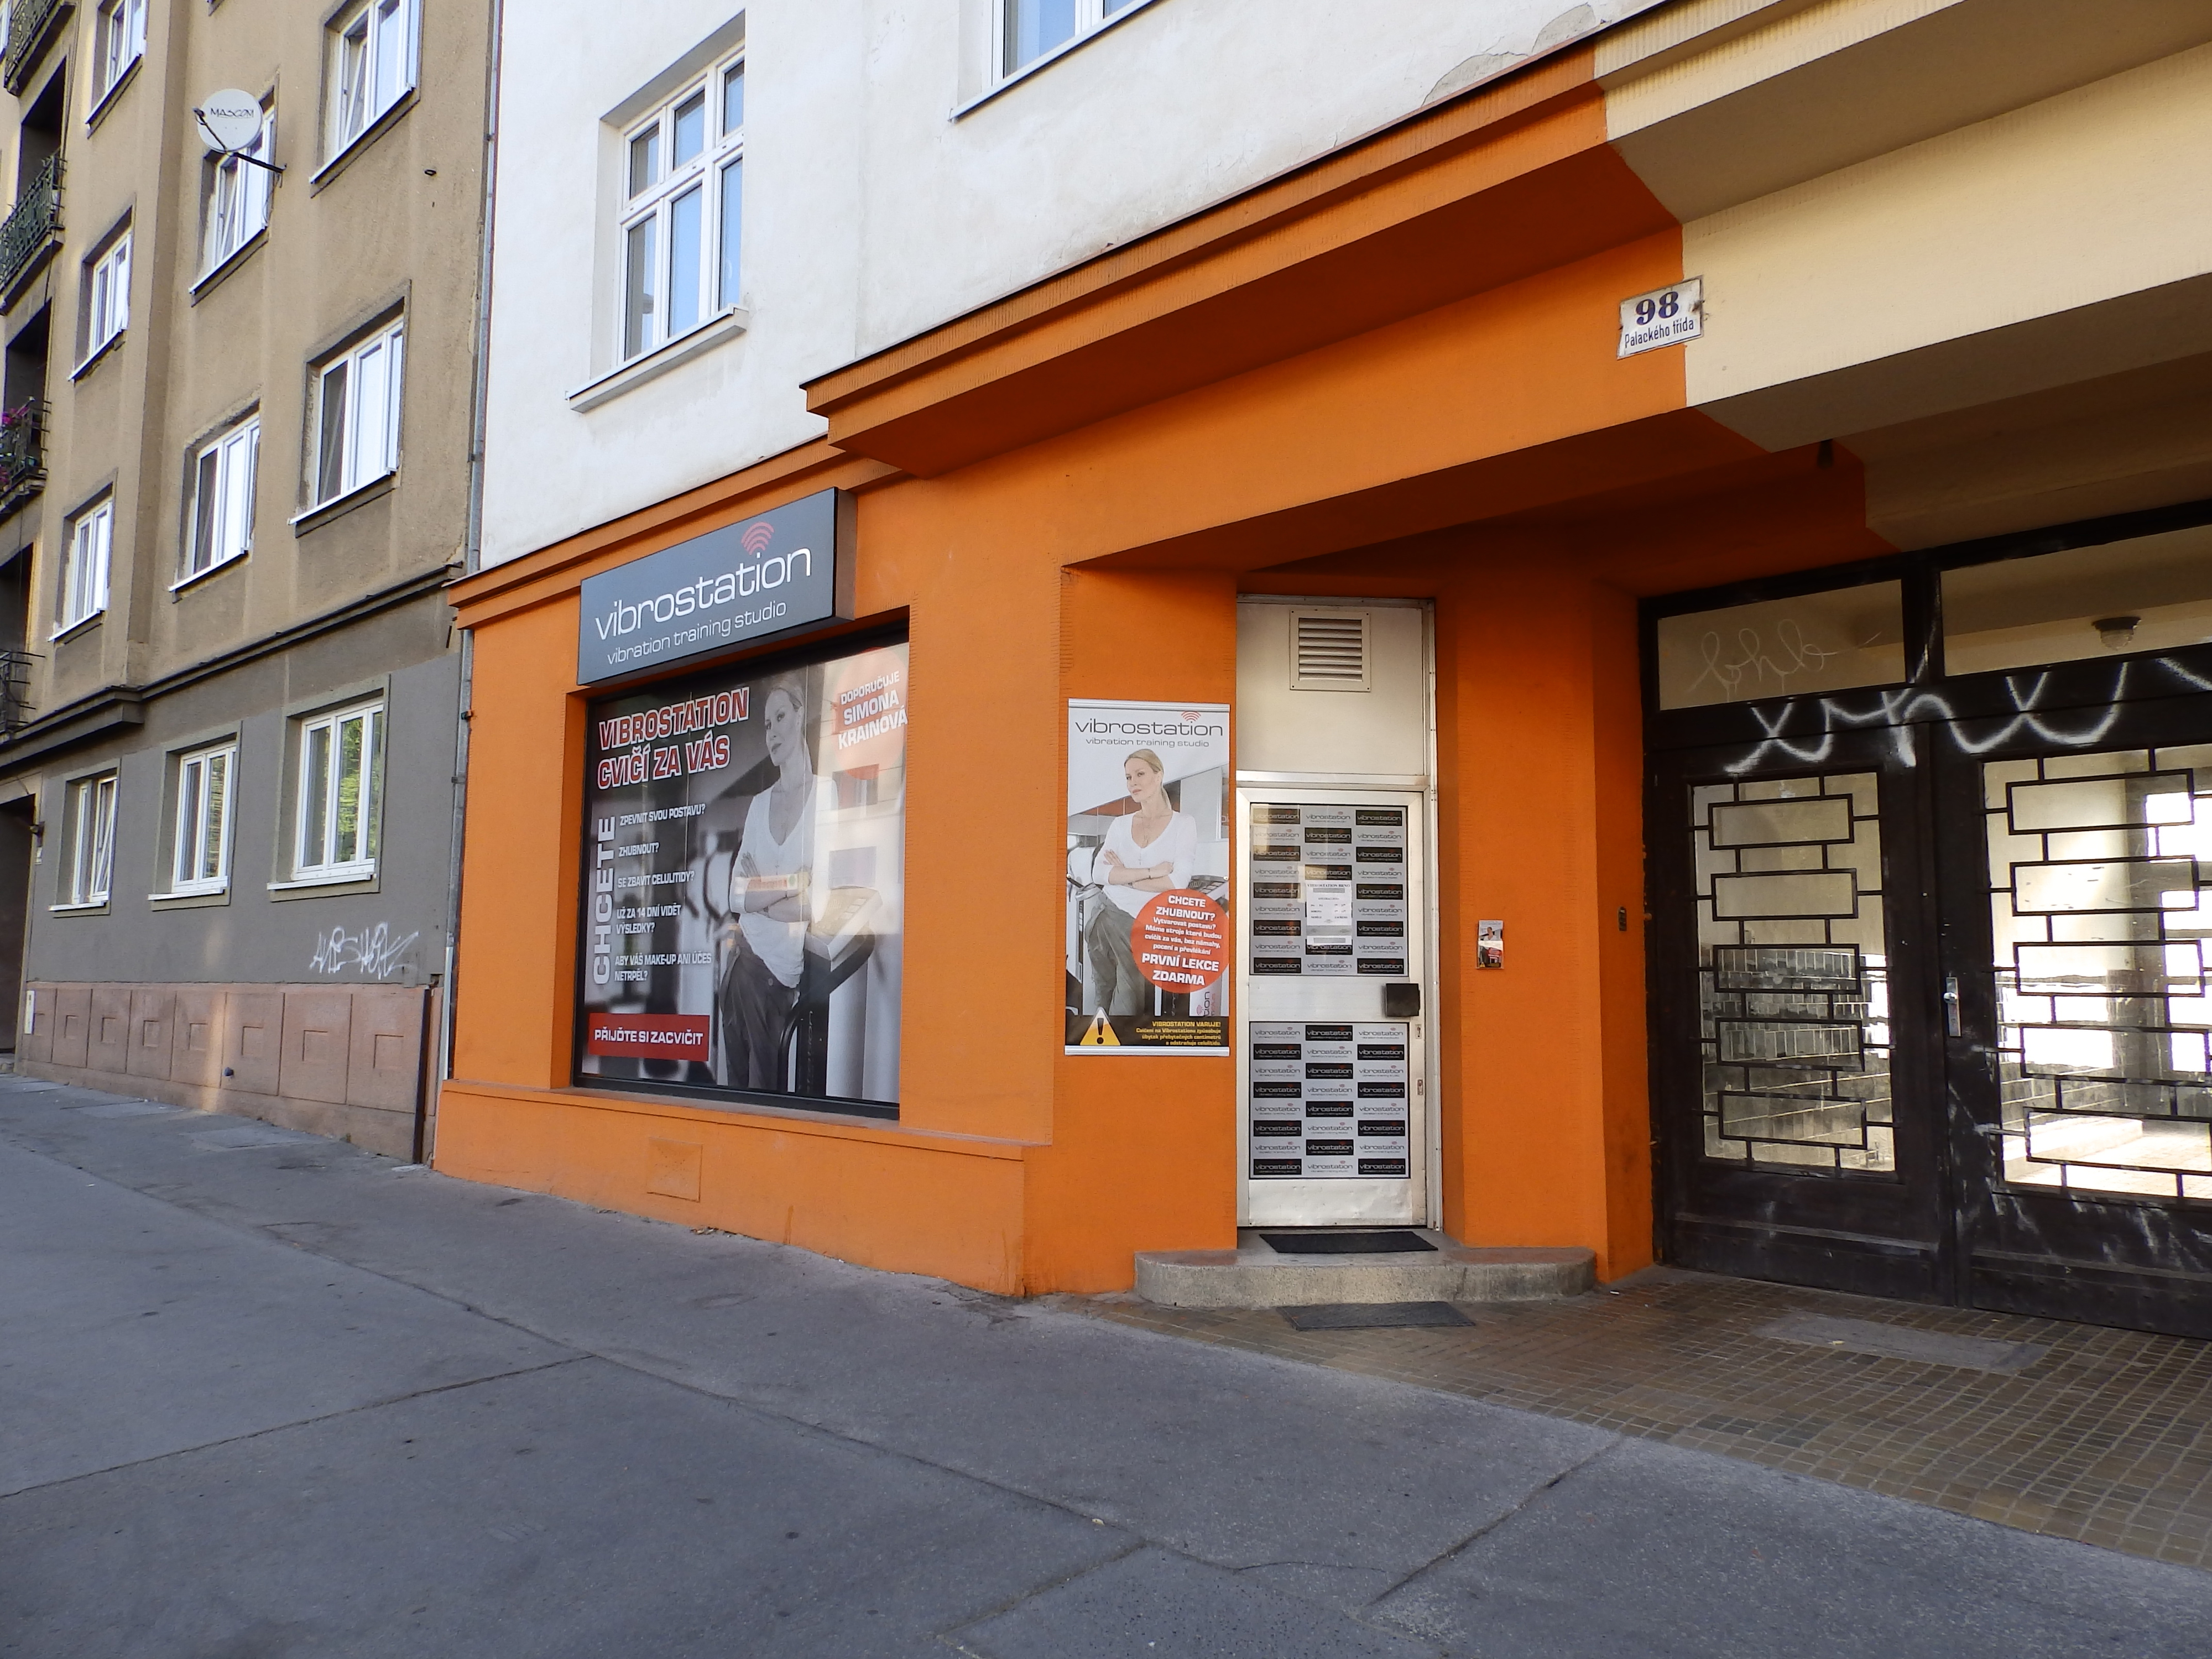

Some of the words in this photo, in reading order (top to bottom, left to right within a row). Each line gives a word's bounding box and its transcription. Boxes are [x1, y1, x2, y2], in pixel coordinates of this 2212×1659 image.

[1635, 291, 1679, 326] 98
[1625, 325, 1670, 348] Palackého
[1673, 316, 1694, 334] třída
[595, 547, 811, 640] vibrostation
[607, 637, 670, 665] vibration
[674, 617, 731, 646] training
[734, 601, 787, 629] studio
[841, 671, 900, 705] DOPORUČUJE
[843, 690, 899, 726] SIMONA
[598, 687, 750, 750] VIBROSTATION
[838, 705, 908, 750] KRAINOVÁ
[1075, 718, 1223, 736] vibrostation
[1136, 739, 1175, 748] training
[597, 743, 650, 790] CVIČÍ
[653, 747, 682, 780] ZA
[686, 731, 731, 775] VÁS
[620, 812, 648, 826] ZPEVNIT
[649, 810, 667, 822] SVOU
[669, 804, 706, 820] POSTAVU?
[618, 842, 659, 857] ZHUBNOUT?
[618, 878, 627, 888] SE
[627, 875, 651, 887] ZBAVIT
[652, 871, 695, 885] CELULITIDY?
[593, 816, 615, 984] CHCETE
[1168, 895, 1206, 907] CHCETE
[617, 906, 626, 919] UŽ
[626, 908, 635, 919] ZA
[637, 907, 645, 917] 14
[646, 904, 660, 917] DNÍ
[660, 902, 681, 916] VIDĚT
[1156, 906, 1215, 921] ZHUBNOUT?
[616, 922, 655, 934] VÝSLEDKY?
[1153, 917, 1187, 926] Vytvarovat
[1188, 922, 1216, 930] postavu?
[1166, 927, 1184, 935] stroje
[615, 956, 629, 966] ABY
[630, 953, 644, 966] VÁŠ
[644, 954, 676, 965] MAKE-UP
[677, 953, 691, 964] ANI
[692, 951, 712, 964] ÚČES
[1142, 953, 1181, 967] PRVNÍ
[1182, 958, 1219, 972] LEKCE
[614, 968, 648, 981] NETRPĚL?
[1152, 970, 1205, 985] ZDARMA
[594, 1026, 638, 1043] PŘIJĎTE
[638, 1030, 649, 1043] SI
[650, 1027, 703, 1046] ZACVIČIT
